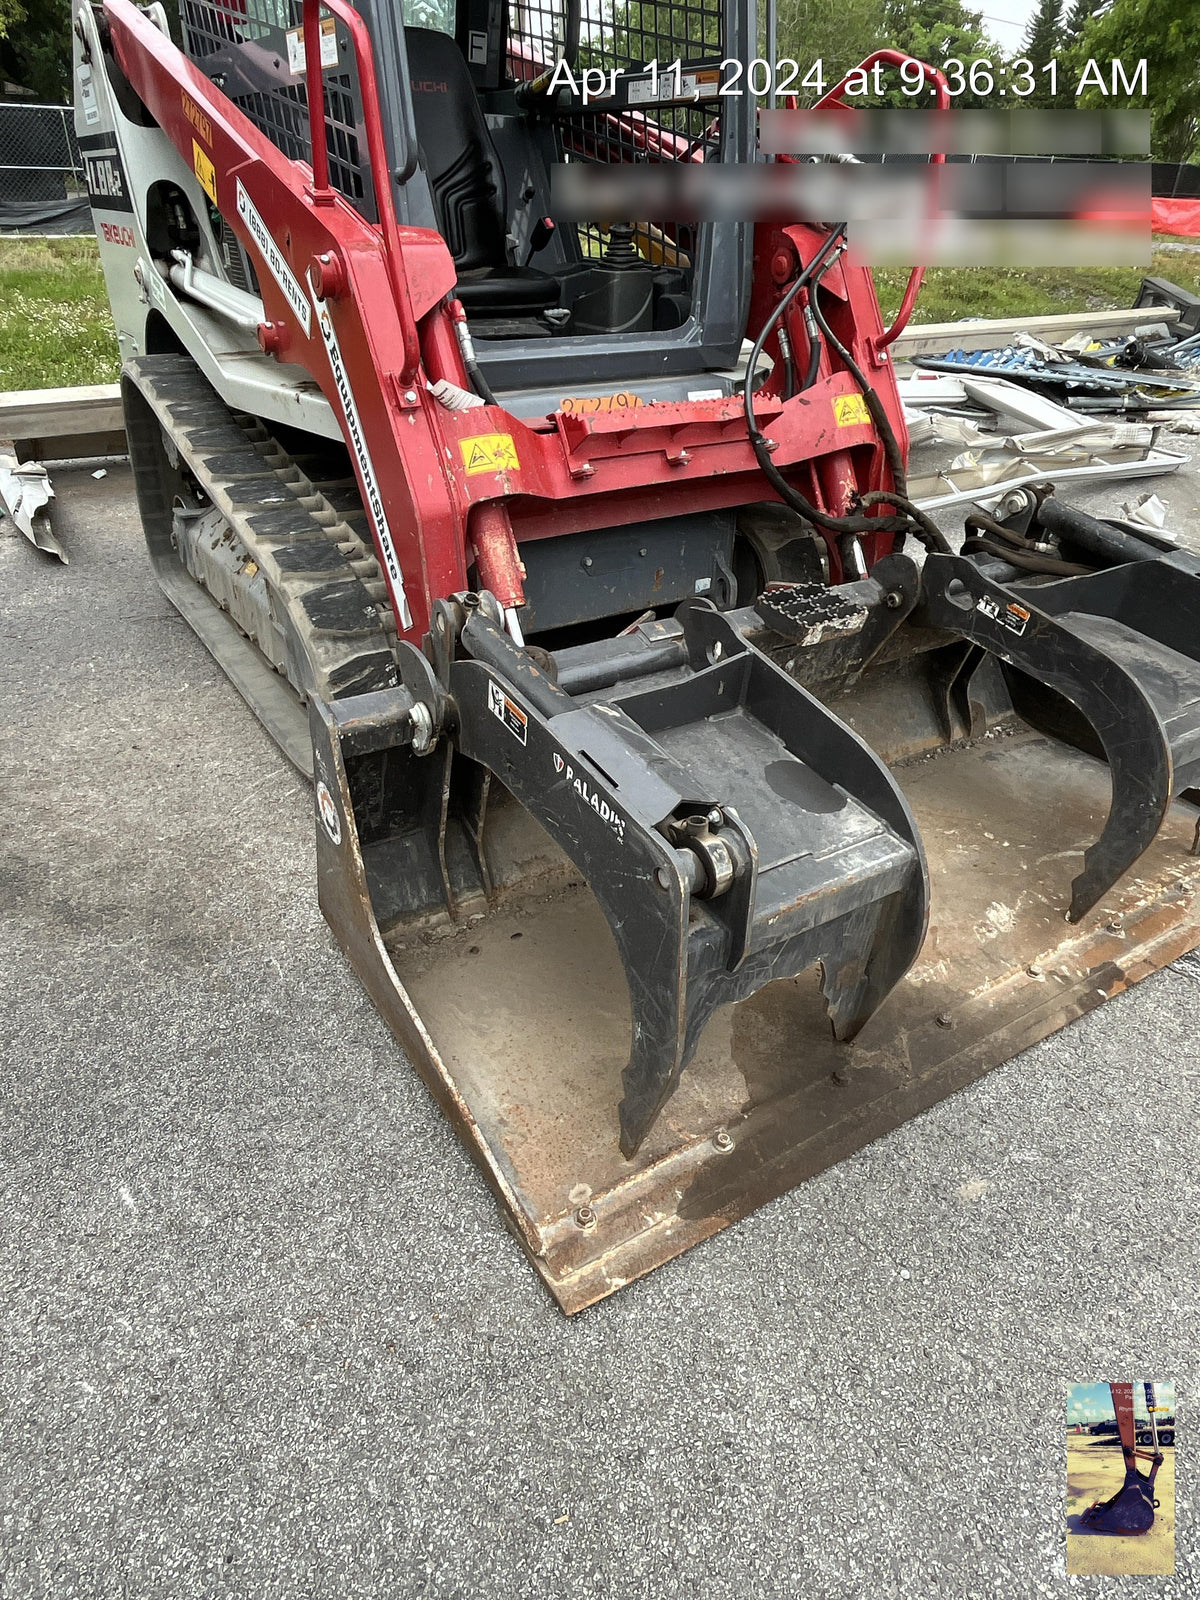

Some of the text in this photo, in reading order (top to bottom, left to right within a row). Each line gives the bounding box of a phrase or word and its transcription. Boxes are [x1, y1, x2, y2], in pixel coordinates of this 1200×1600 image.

[470, 33, 486, 60] F
[411, 80, 448, 93] UCHI
[249, 208, 308, 321] (888) 80-RENTS
[329, 342, 398, 581] EquipmentShare
